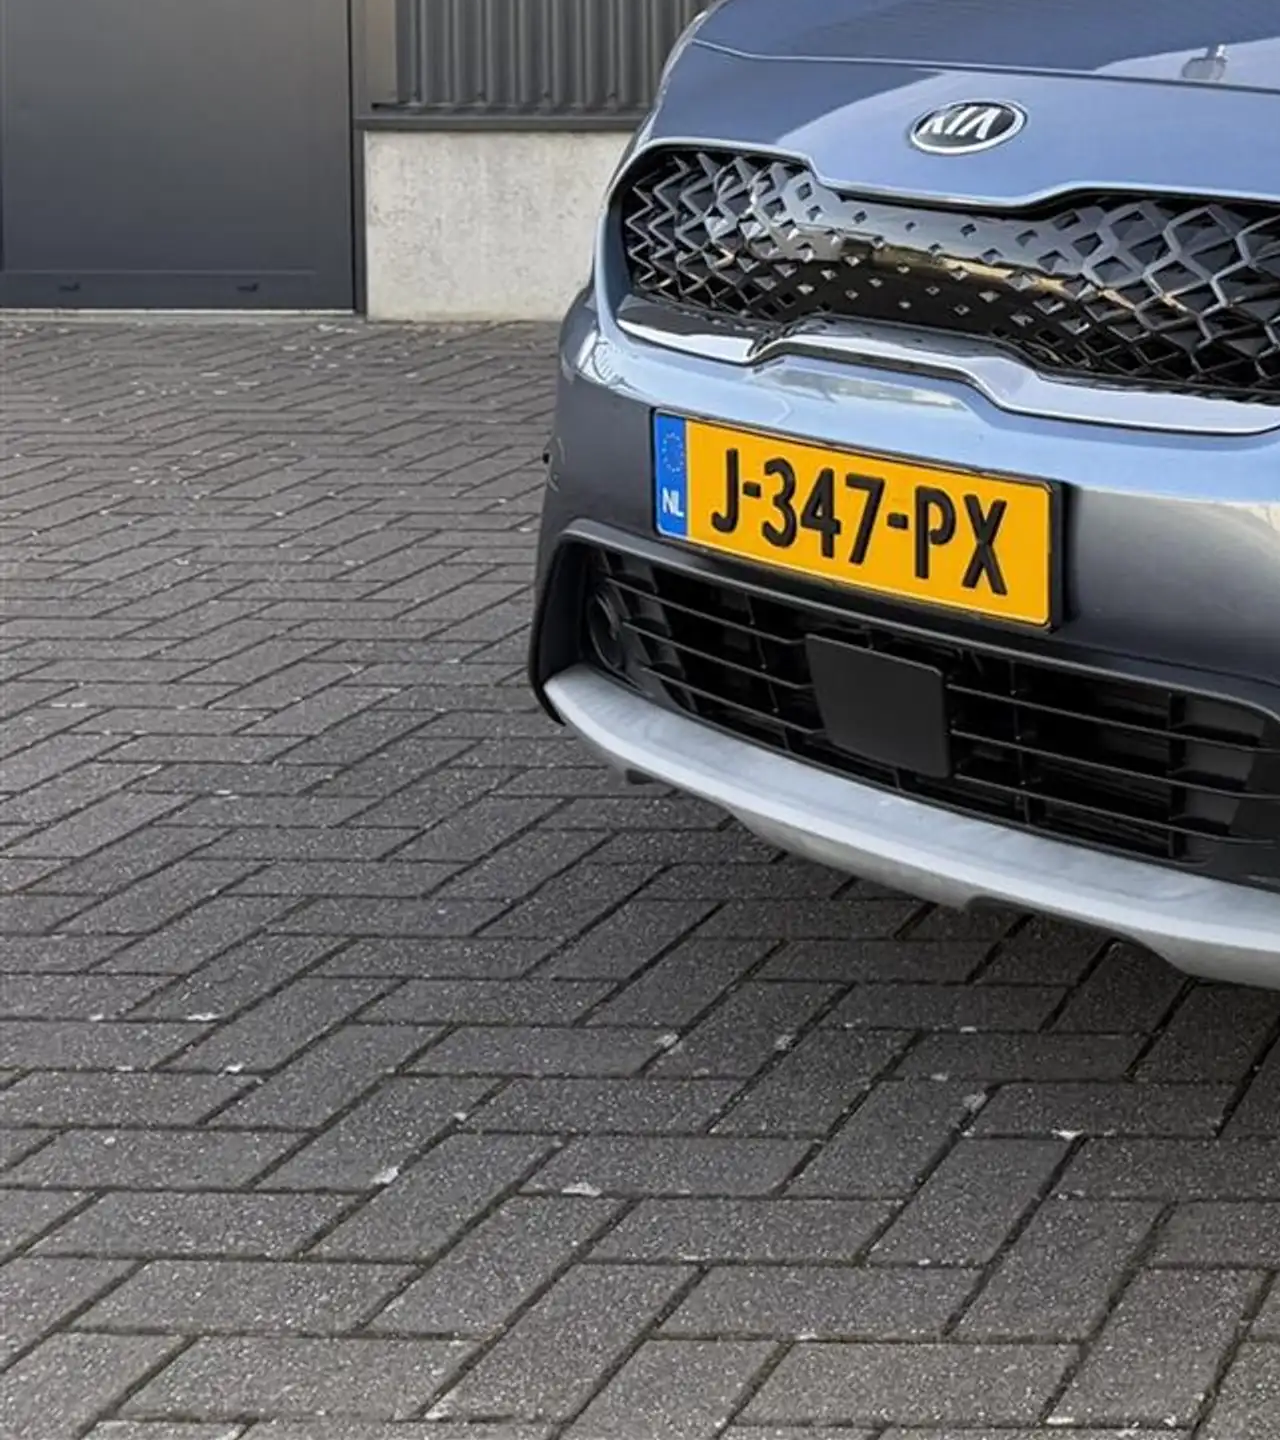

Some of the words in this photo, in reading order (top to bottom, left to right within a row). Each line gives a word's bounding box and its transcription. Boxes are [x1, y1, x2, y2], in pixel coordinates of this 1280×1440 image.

[919, 105, 1001, 140] KIA
[661, 486, 685, 518] NL
[711, 448, 1008, 596] J-347-PX
